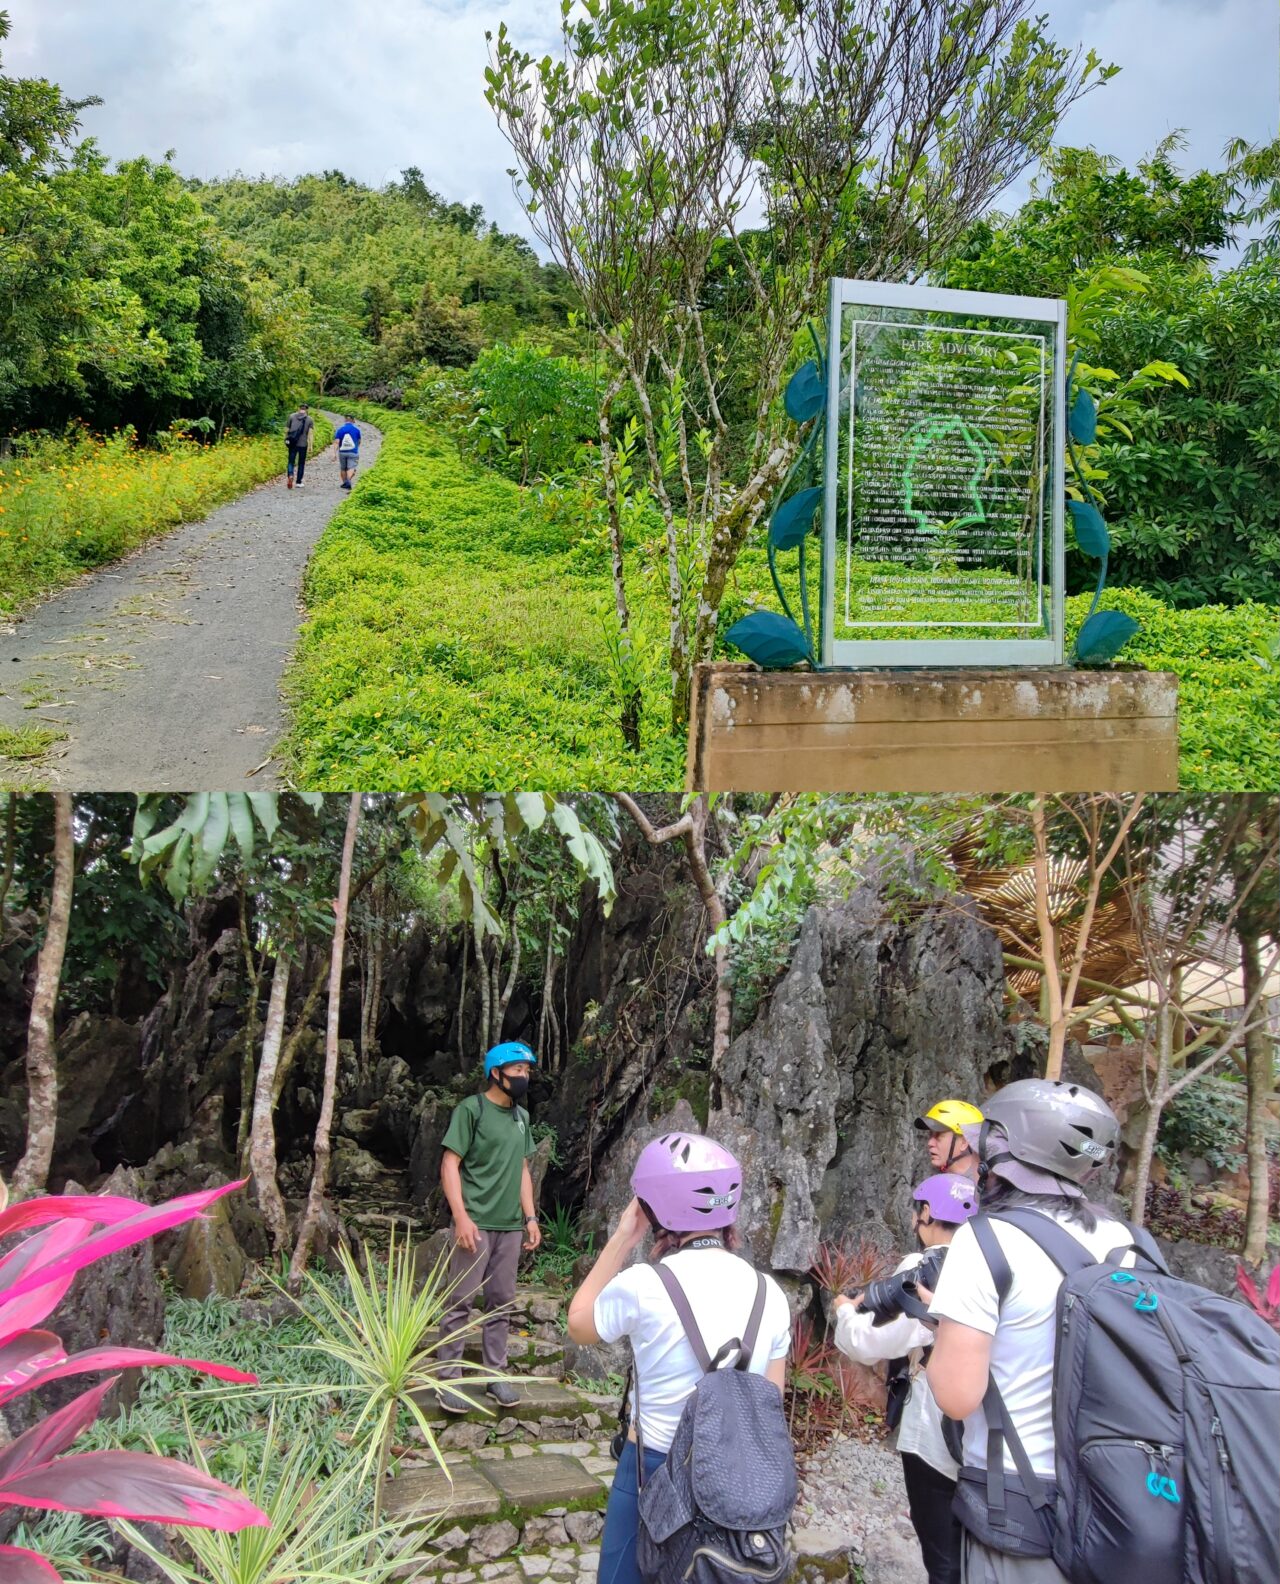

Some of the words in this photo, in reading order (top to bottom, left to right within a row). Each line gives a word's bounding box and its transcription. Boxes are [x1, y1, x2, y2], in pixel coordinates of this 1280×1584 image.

[901, 338, 934, 353] PARK
[938, 341, 999, 358] ADVISORY
[692, 1238, 721, 1248] SONY
